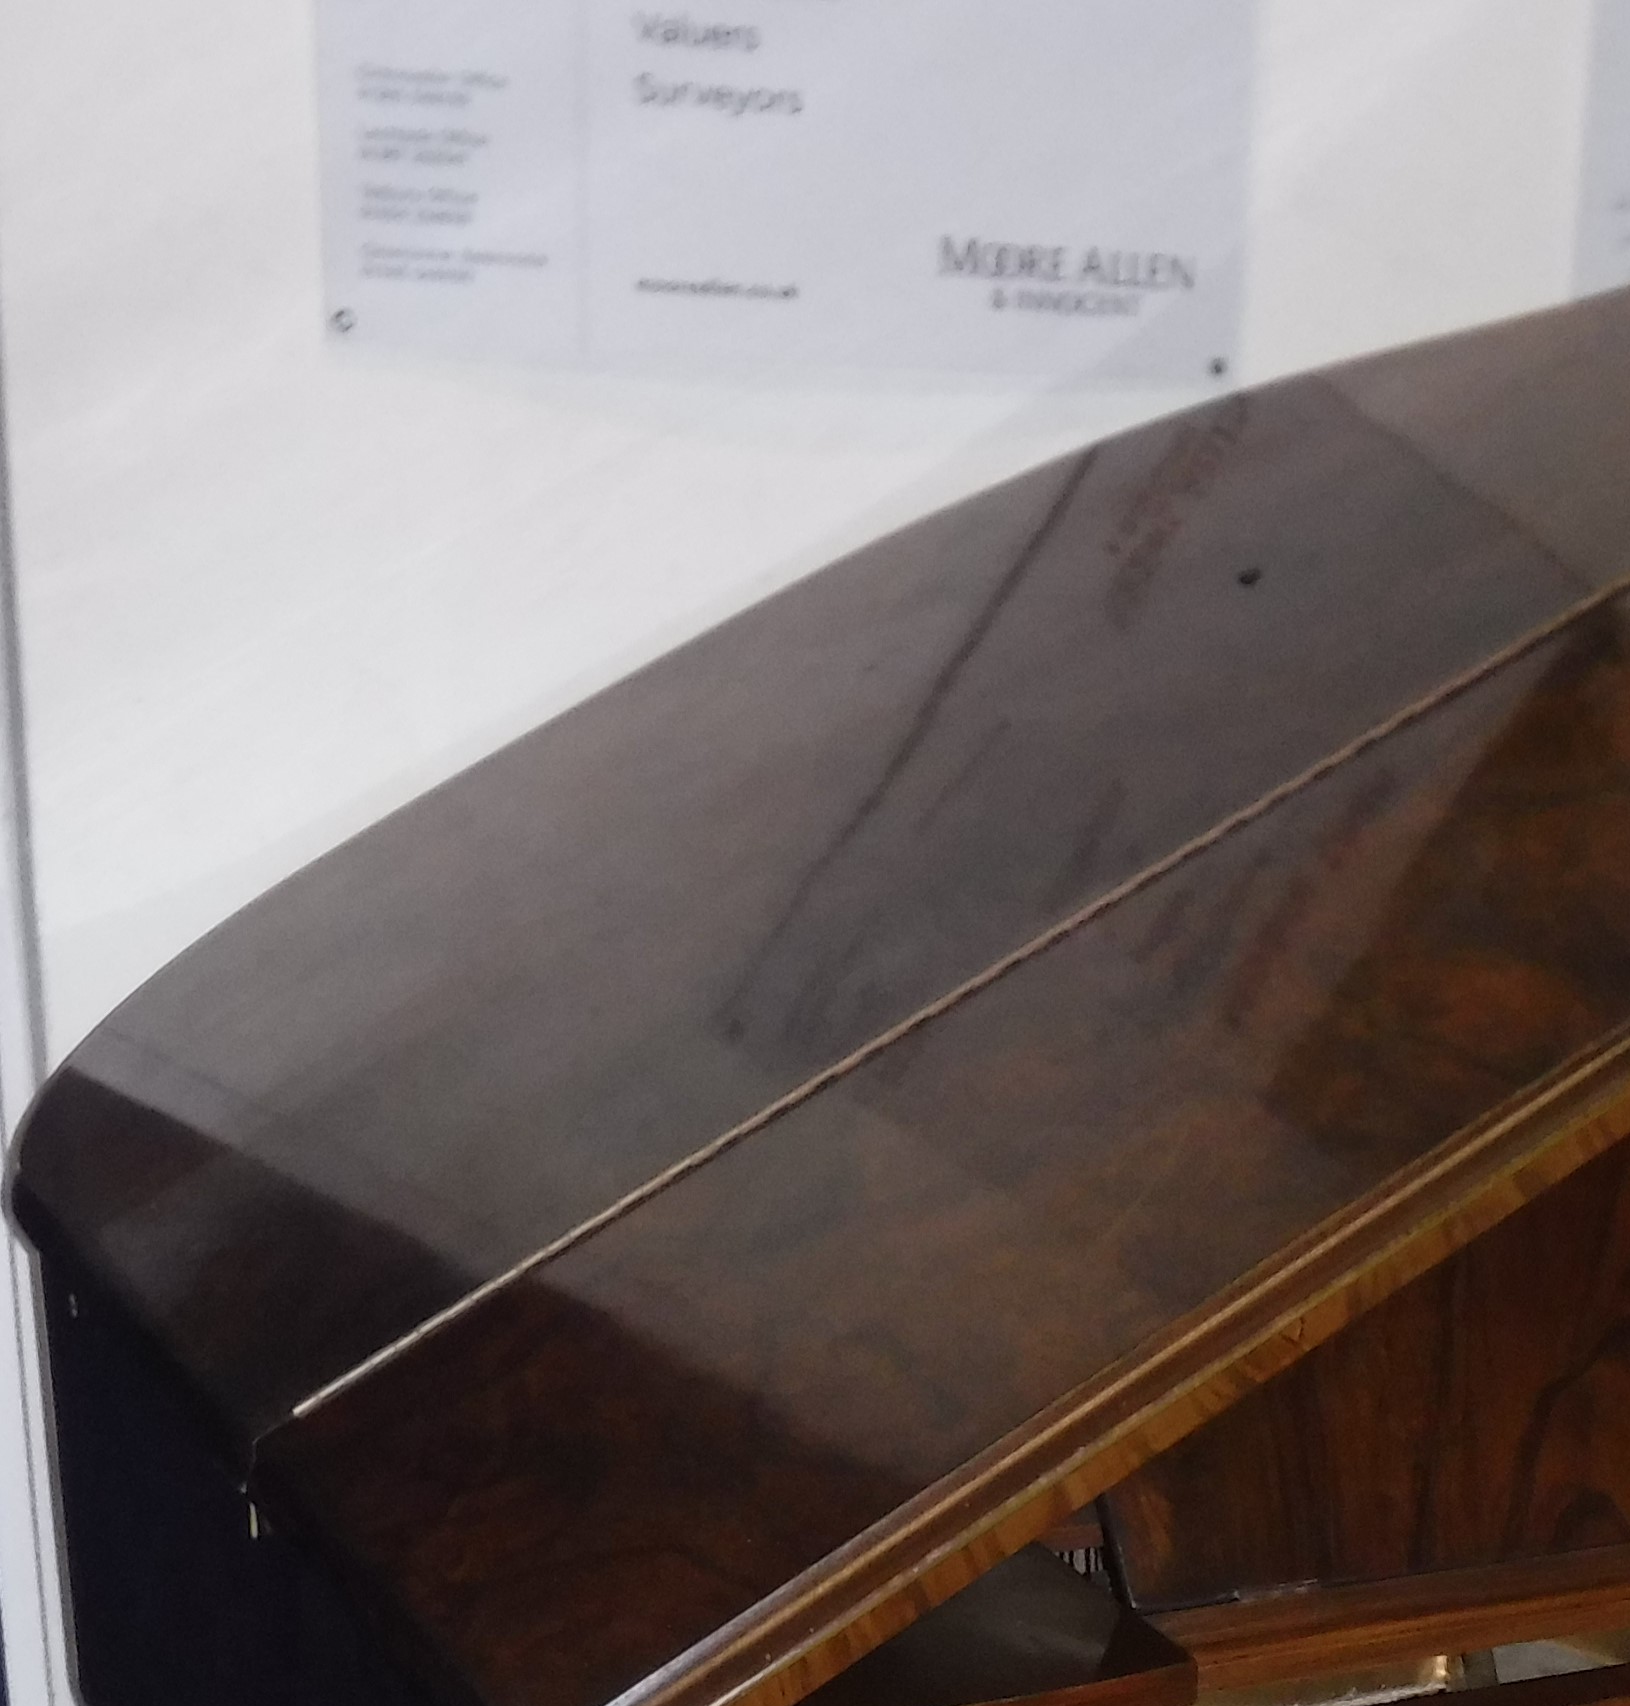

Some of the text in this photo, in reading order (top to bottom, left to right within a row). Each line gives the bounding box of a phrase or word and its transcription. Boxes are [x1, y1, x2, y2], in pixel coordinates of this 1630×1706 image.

[631, 9, 761, 53] Valuers
[634, 72, 804, 117] Surveyors
[937, 232, 1197, 291] MOORE ALLEN
